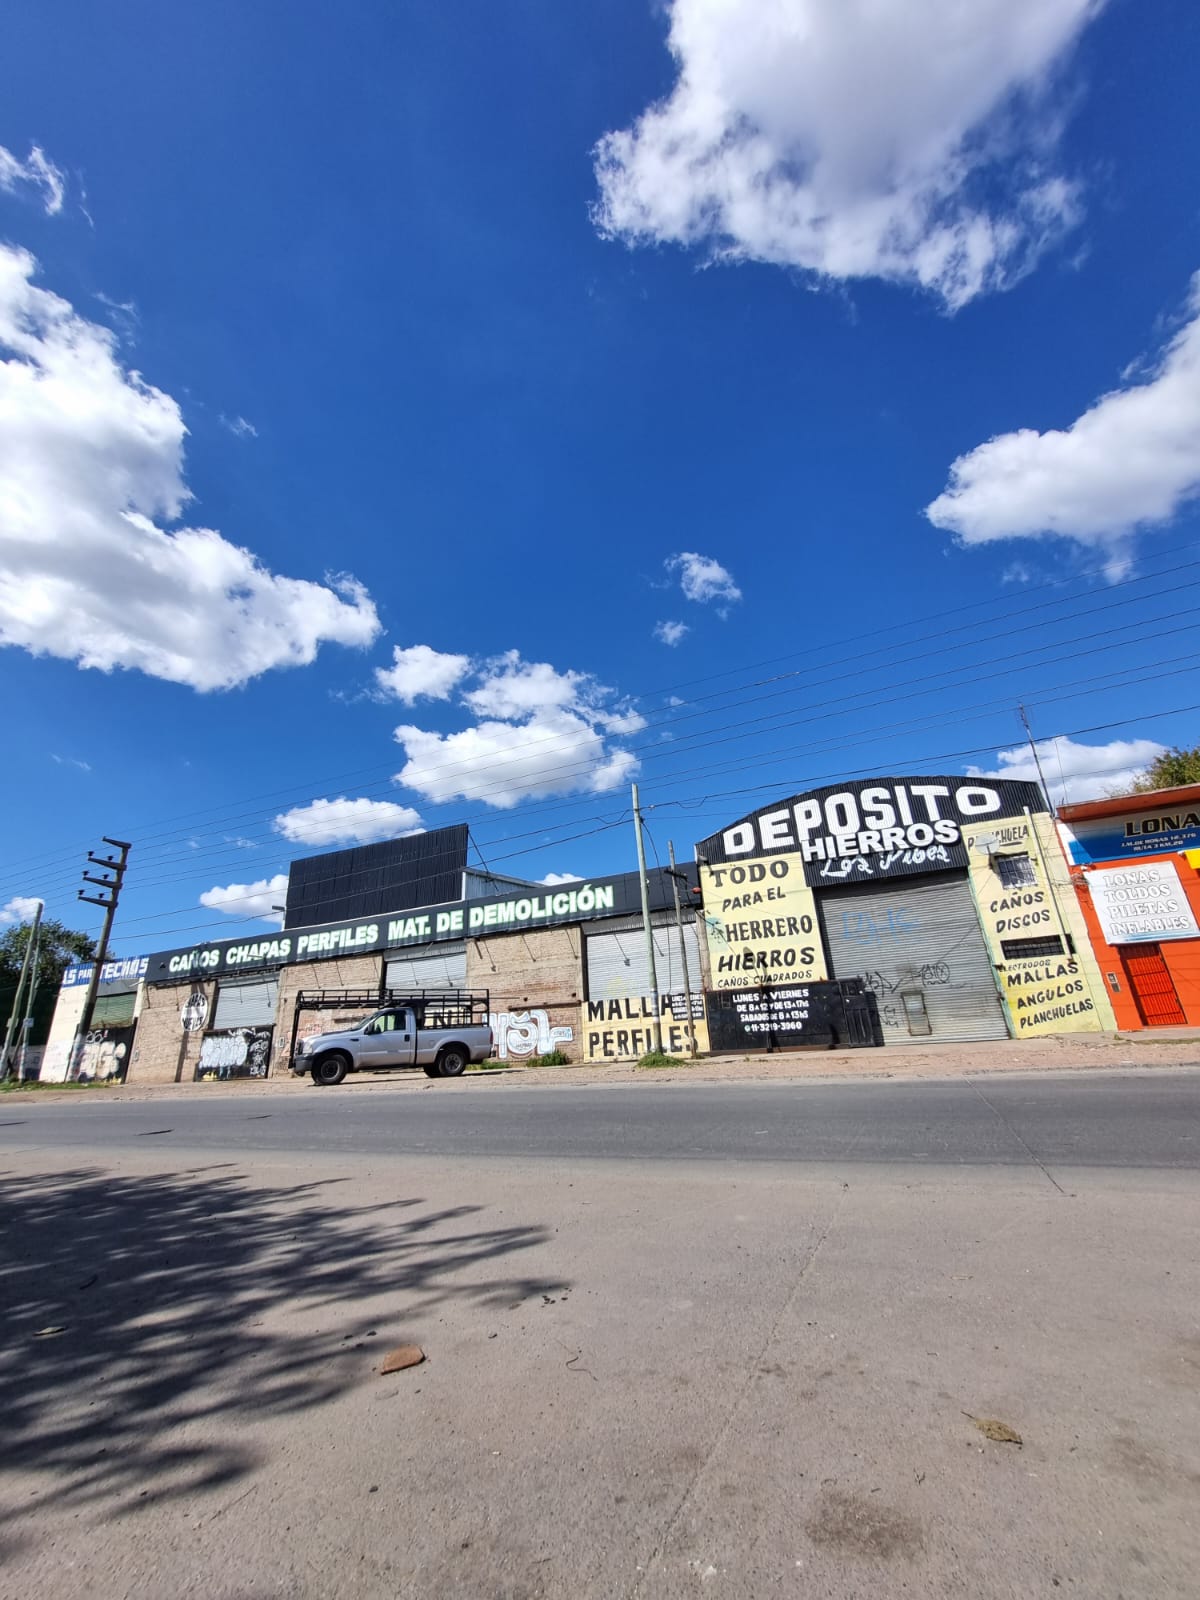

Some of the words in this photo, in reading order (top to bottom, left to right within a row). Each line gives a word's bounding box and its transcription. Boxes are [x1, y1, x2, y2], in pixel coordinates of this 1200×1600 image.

[723, 784, 1001, 856] DEPOSITO
[1124, 812, 1200, 838] LONA
[801, 819, 959, 862] HIERROS
[709, 860, 789, 887] TODO
[1103, 869, 1160, 888] LONAS
[722, 891, 763, 912] PARA
[767, 886, 786, 900] EL
[990, 891, 1045, 913] CAÑOS
[1104, 884, 1171, 903] TOLDOS
[996, 909, 1050, 933] DISCOS
[1107, 899, 1178, 919] PILETAS
[226, 938, 291, 965] CHAPAS
[297, 924, 379, 954] PERFILES
[388, 915, 431, 941] MAT.
[436, 908, 464, 933] DE
[469, 884, 614, 928] DEMOLICIÓN
[725, 915, 812, 942] HERRERO
[1109, 916, 1190, 936] INFLABLES
[718, 946, 815, 972] HIERROS
[717, 975, 749, 988] CAÑOS
[753, 969, 812, 985] CUADRADOS
[1007, 961, 1079, 987] MALLAS
[732, 993, 760, 1003] LUNES
[770, 988, 809, 1000] VIERNES
[736, 1004, 747, 1012] DE
[774, 1001, 783, 1010] DE
[1017, 979, 1084, 1010] ANGULOS
[1020, 998, 1094, 1029] PLANCHUELAS
[589, 1024, 698, 1057] PERFIES
